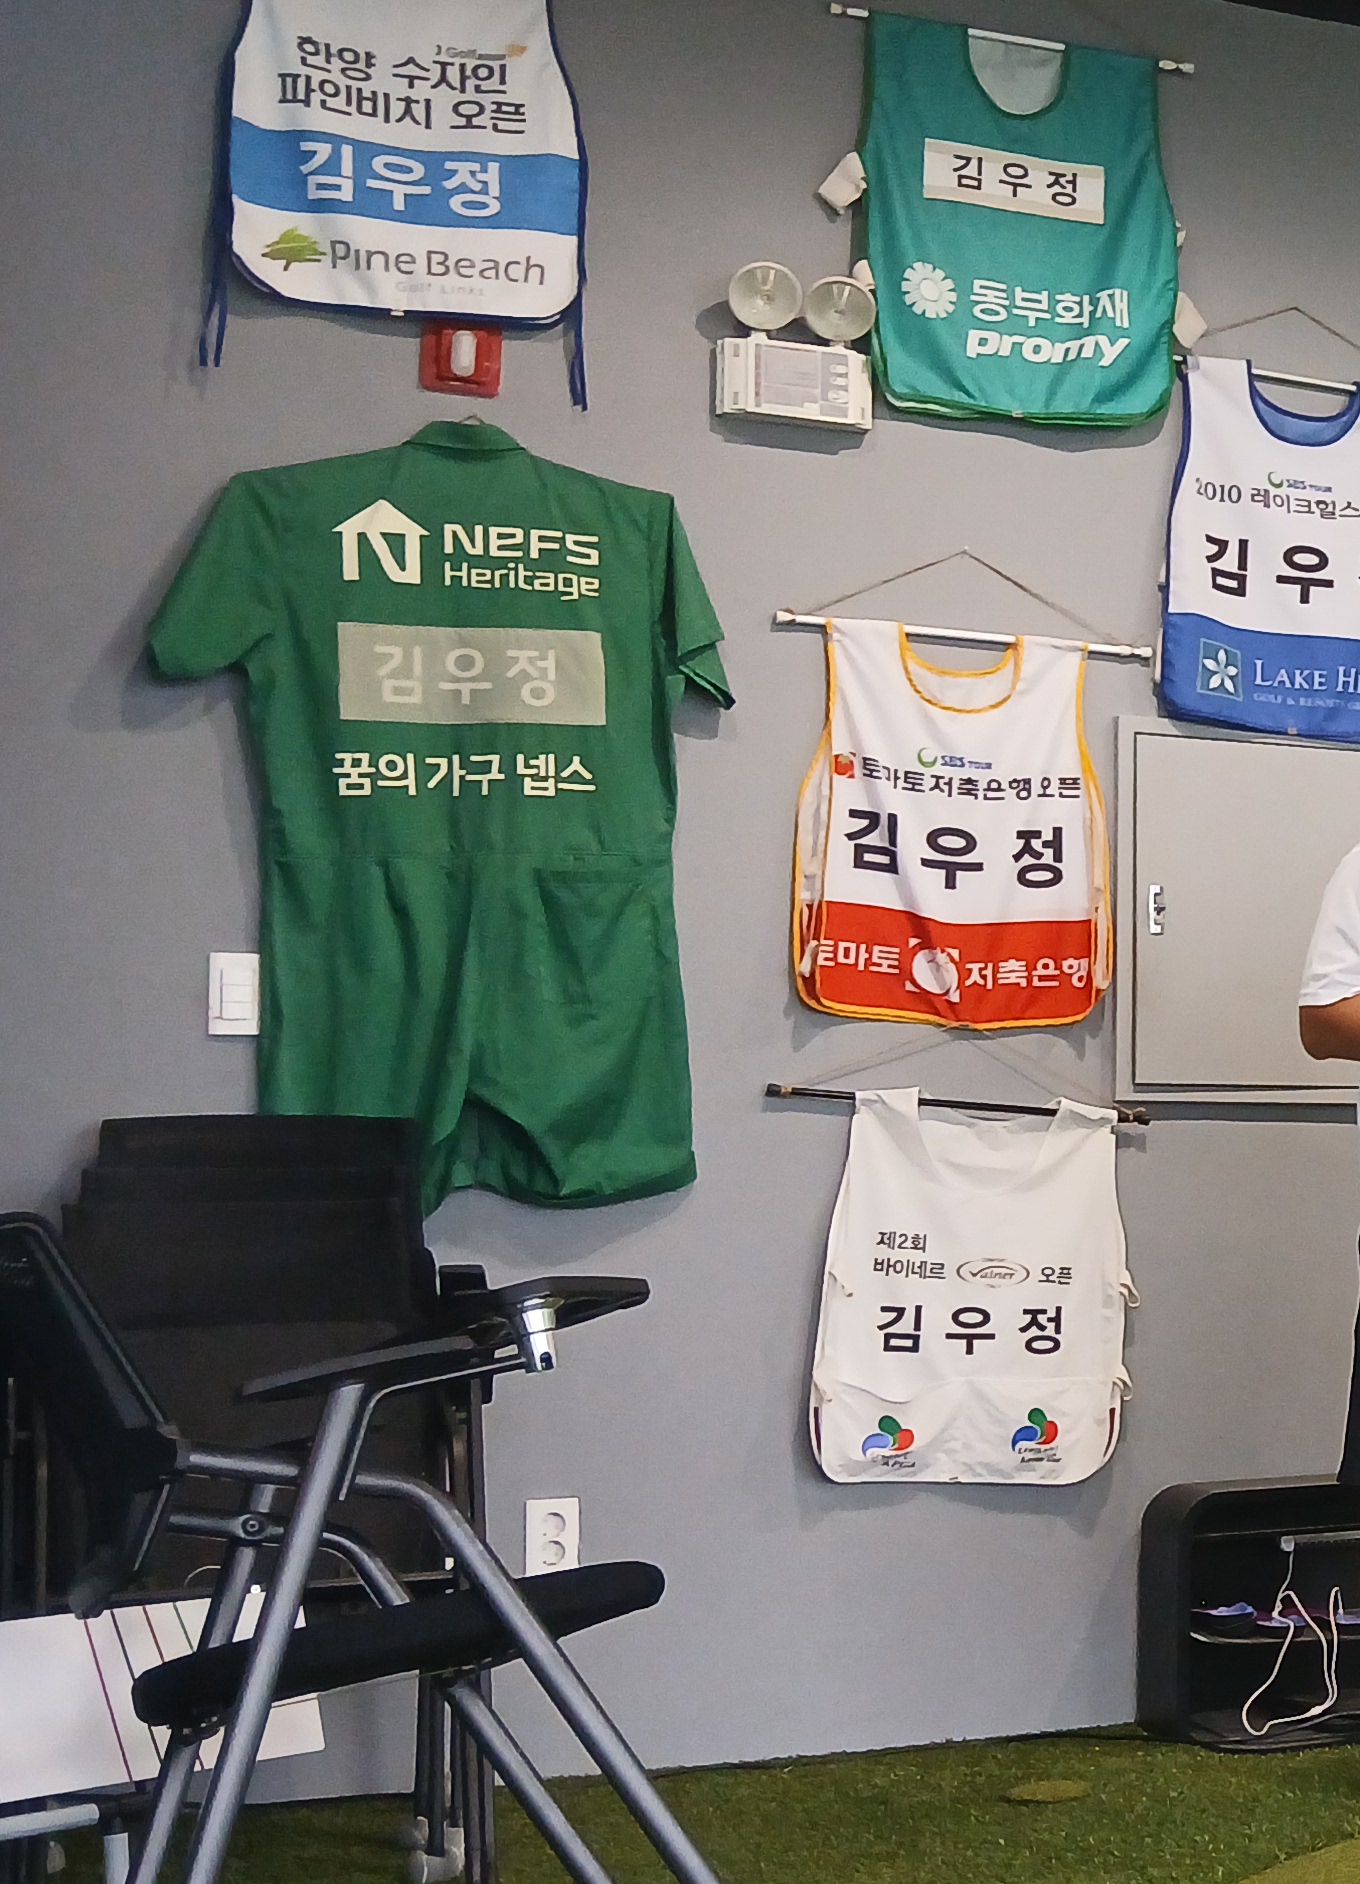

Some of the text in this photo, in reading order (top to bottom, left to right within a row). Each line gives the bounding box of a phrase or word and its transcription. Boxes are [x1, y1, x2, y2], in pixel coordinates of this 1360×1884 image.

[297, 36, 507, 95] 한양 수자인
[277, 72, 528, 135] 파인비치 오픈
[300, 142, 501, 218] 김우정
[952, 153, 1079, 208] 김우정
[330, 239, 546, 286] Pine Beach
[970, 279, 1130, 329] 동부화재
[966, 329, 1131, 367] promy
[1195, 477, 1243, 504] 2010
[443, 560, 601, 602] Heritage
[372, 643, 558, 708] 김우정
[1254, 658, 1328, 691] LAKE
[332, 752, 597, 797] 꿈의 가구 넵스
[843, 808, 1064, 890] 김우정
[964, 956, 1090, 990] 저축은행
[875, 1231, 928, 1254] 제2회
[873, 1257, 946, 1280] 바이네르
[1037, 1265, 1073, 1285] 오픈
[876, 1304, 1063, 1356] 김우정
